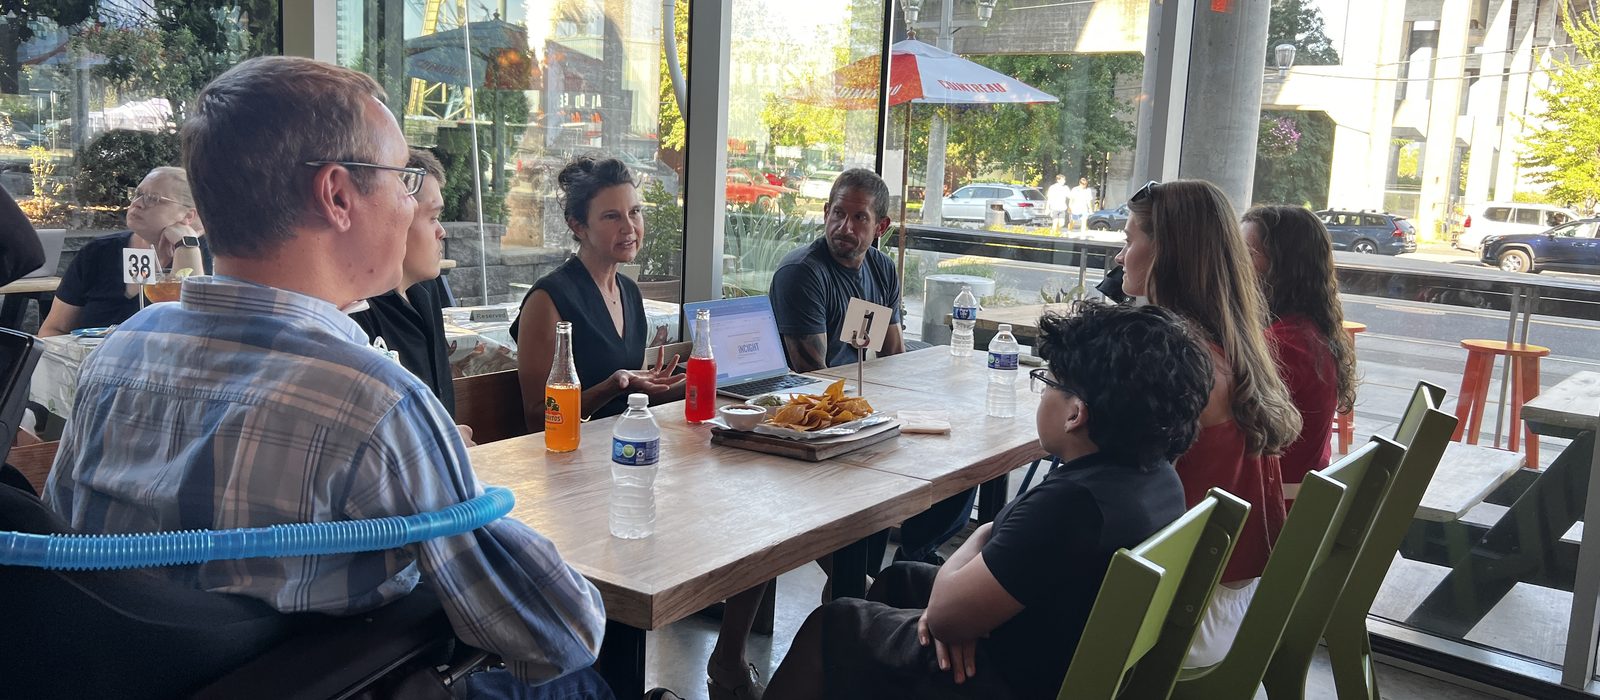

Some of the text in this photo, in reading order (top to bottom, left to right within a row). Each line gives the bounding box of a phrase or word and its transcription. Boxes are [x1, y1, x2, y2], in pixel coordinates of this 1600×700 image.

[129, 254, 150, 279] 38
[476, 312, 507, 320] Reserved
[863, 311, 875, 340] 1
